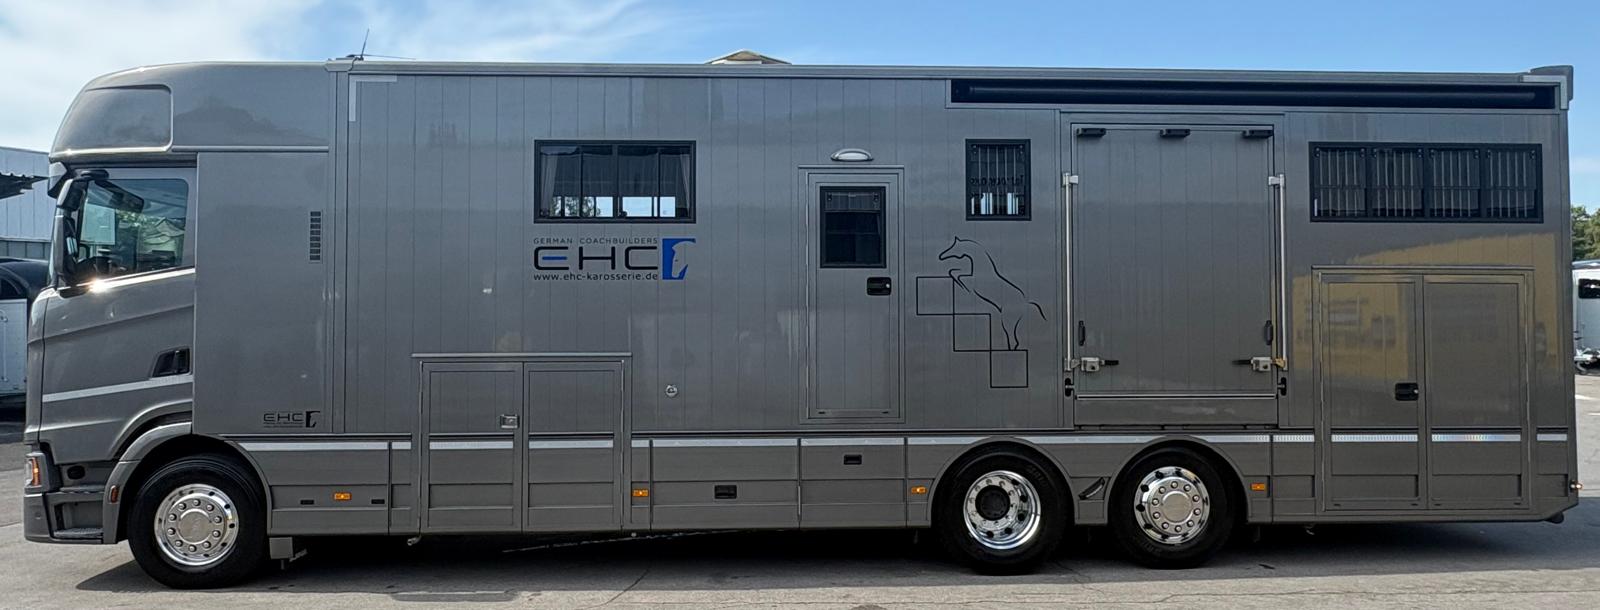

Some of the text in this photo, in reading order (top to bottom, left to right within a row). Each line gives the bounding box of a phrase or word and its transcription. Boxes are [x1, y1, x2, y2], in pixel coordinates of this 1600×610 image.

[533, 237, 658, 245] GERMAN COACHBUILDERS
[533, 246, 658, 271] EHC
[533, 272, 658, 282] www.ehc-karosserie.de
[263, 413, 304, 422] EHC
